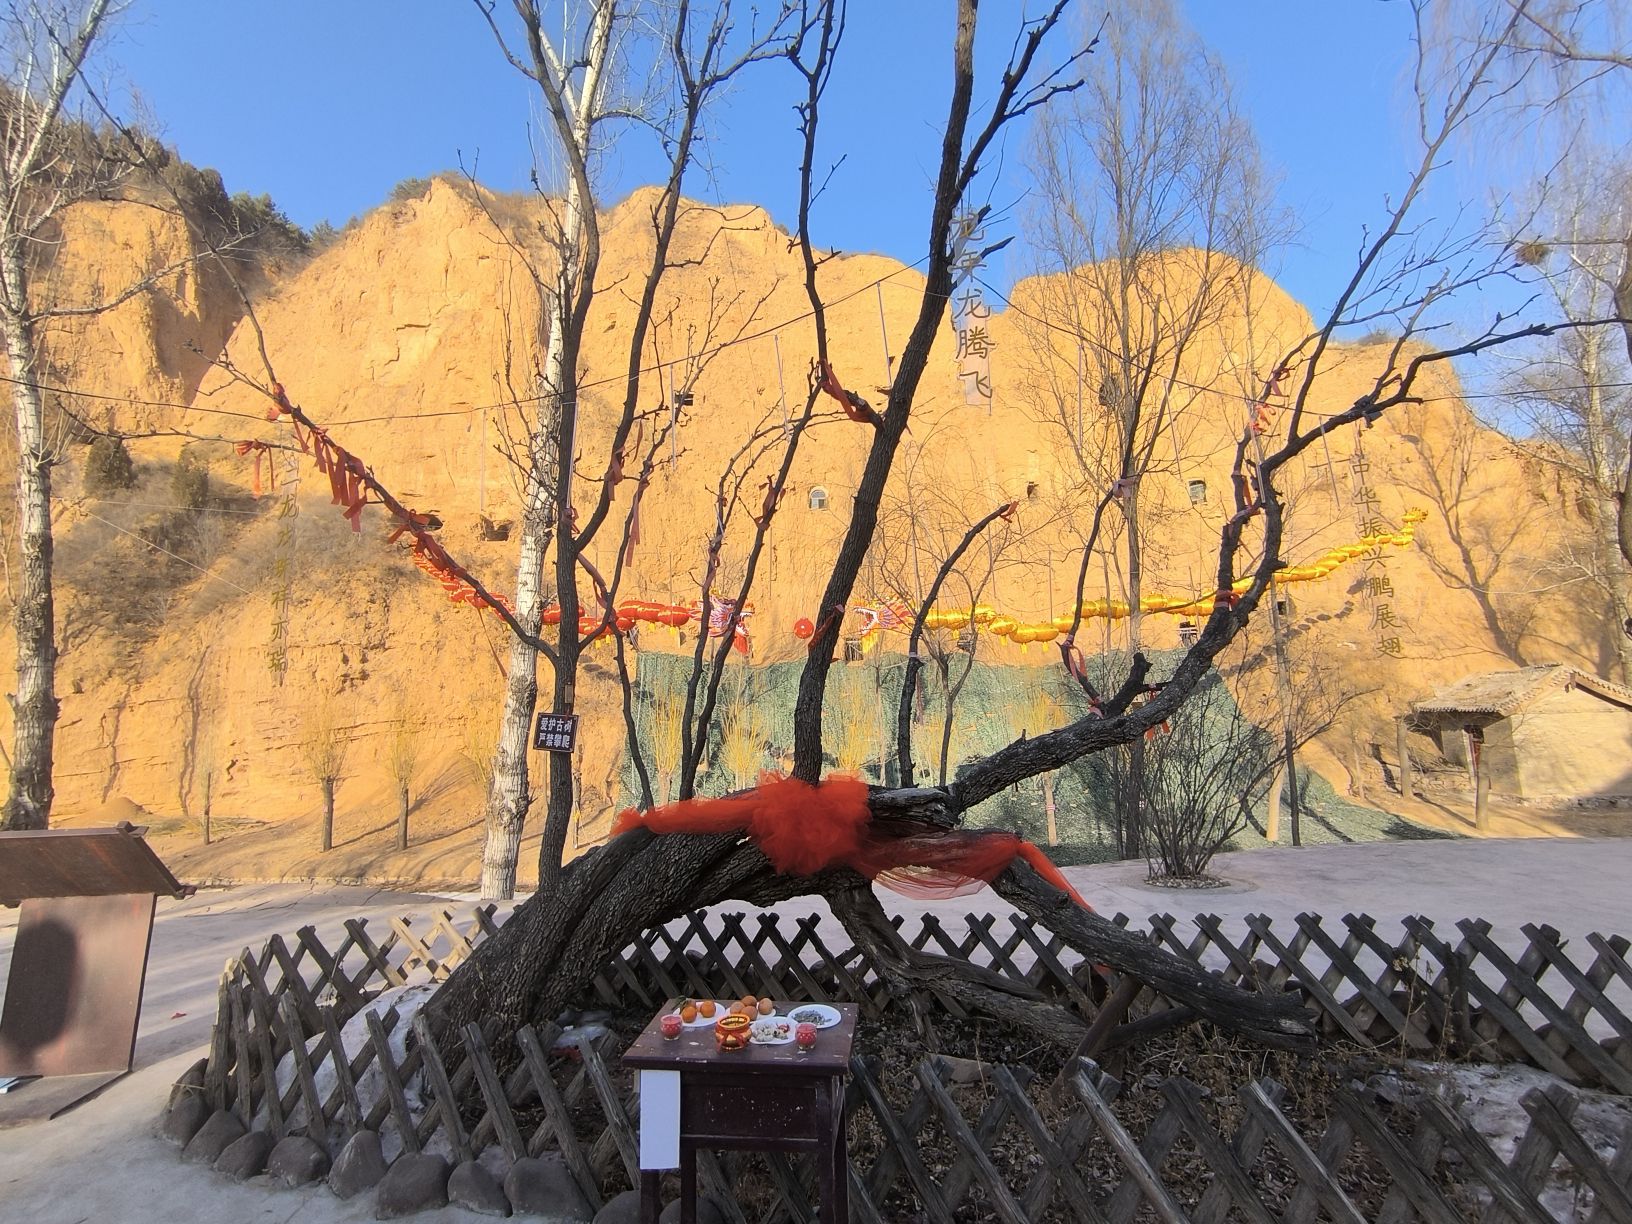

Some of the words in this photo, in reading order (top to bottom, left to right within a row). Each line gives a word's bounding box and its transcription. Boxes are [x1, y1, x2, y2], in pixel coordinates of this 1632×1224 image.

[1352, 458, 1402, 659] 中华振兴鹏展翅
[540, 717, 573, 733] 爱护古树
[537, 732, 571, 749] 严禁攀爬
